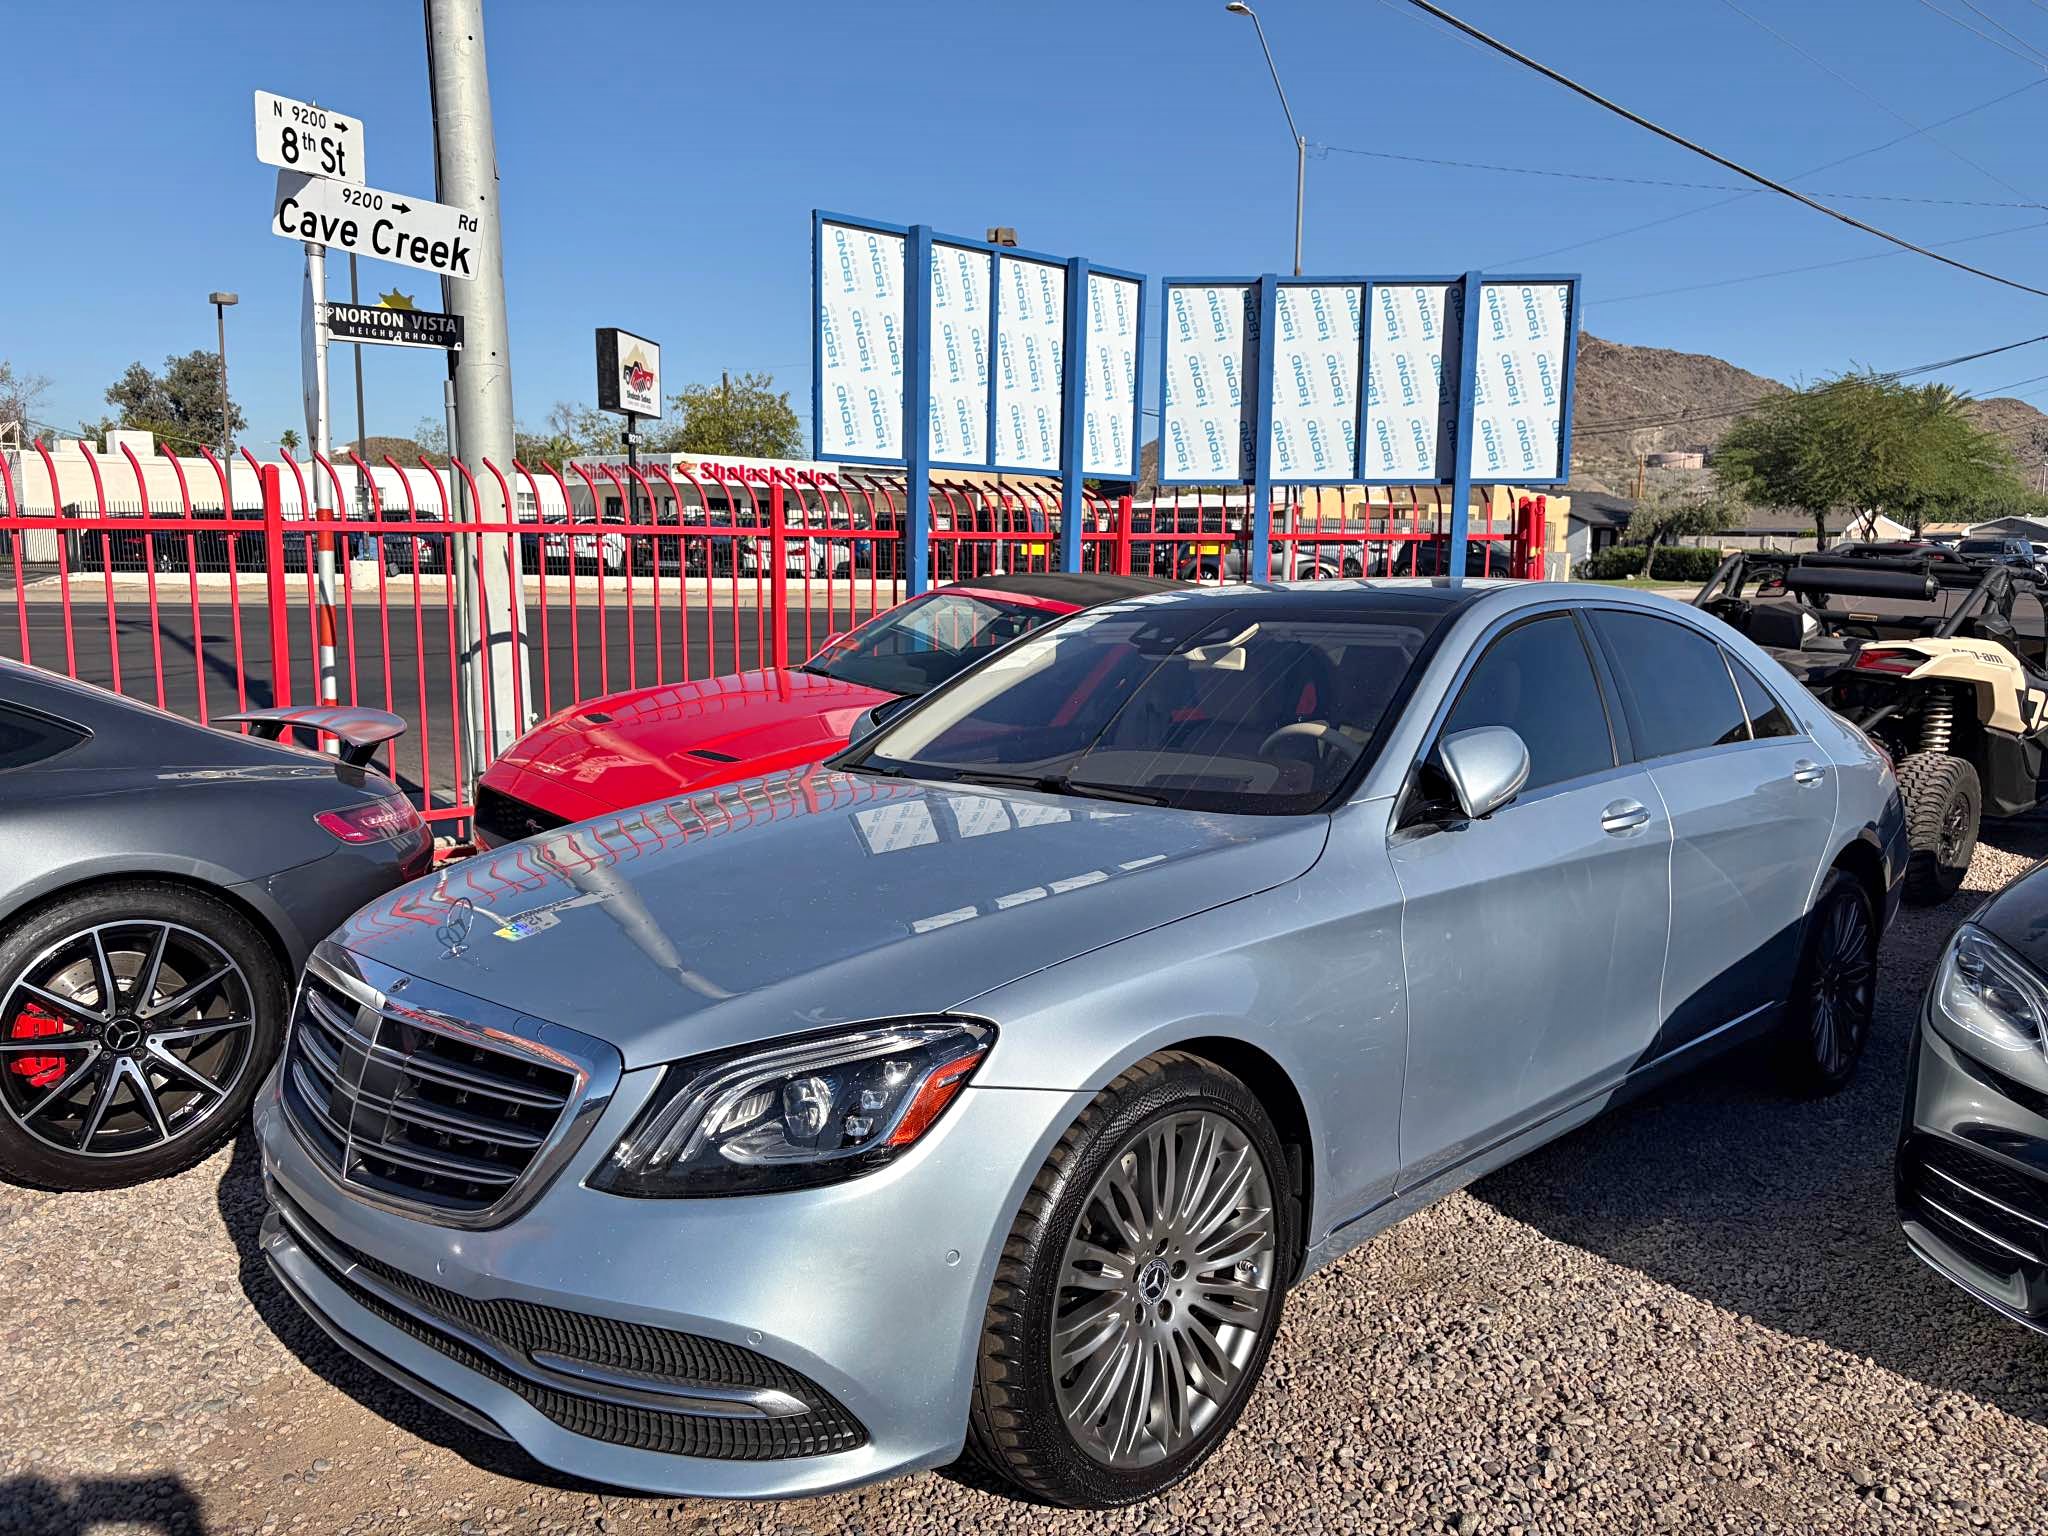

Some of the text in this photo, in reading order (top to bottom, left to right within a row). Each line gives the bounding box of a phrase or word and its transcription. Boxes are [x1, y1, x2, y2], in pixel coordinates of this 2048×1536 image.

[274, 100, 326, 129] N 9200
[281, 126, 346, 176] 8th St
[342, 188, 383, 211] 9200
[279, 197, 471, 274] Cave Creek
[458, 214, 478, 232] Rd
[335, 307, 456, 333] NORTON VISTA
[349, 326, 443, 342] NEIGHBORHOOD
